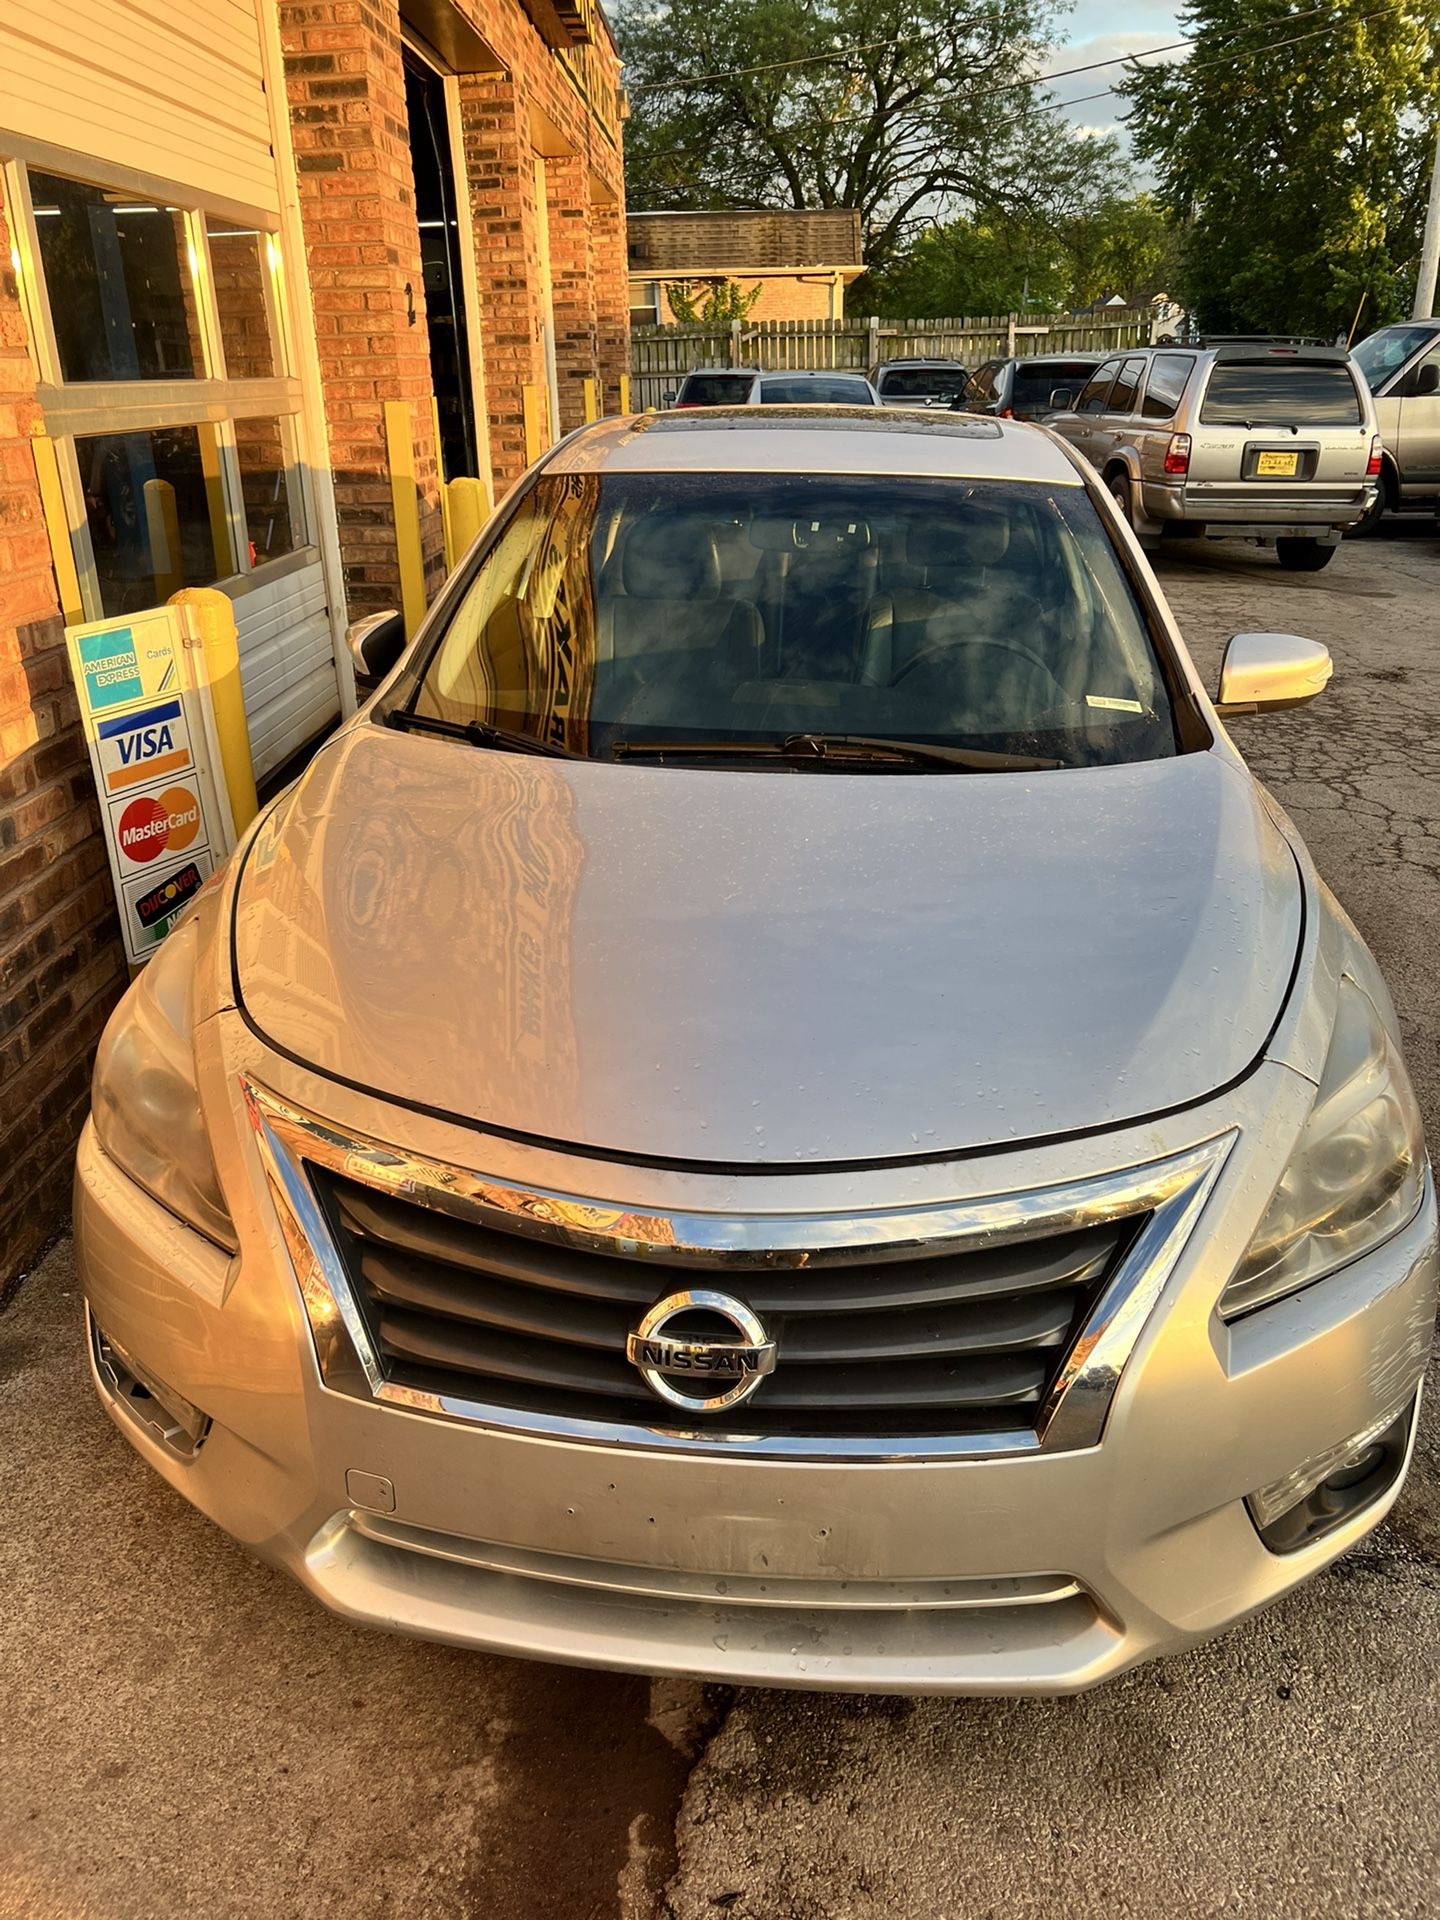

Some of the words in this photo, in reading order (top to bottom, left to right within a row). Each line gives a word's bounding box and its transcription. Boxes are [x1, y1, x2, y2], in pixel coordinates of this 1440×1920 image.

[84, 652, 135, 674] AMERICAN
[146, 647, 172, 659] Cards
[97, 667, 140, 686] EXPRESS
[116, 725, 174, 765] VISA
[122, 806, 197, 846] MasterCard
[140, 869, 198, 916] DISCOVER
[642, 1345, 759, 1373] NISSAN
